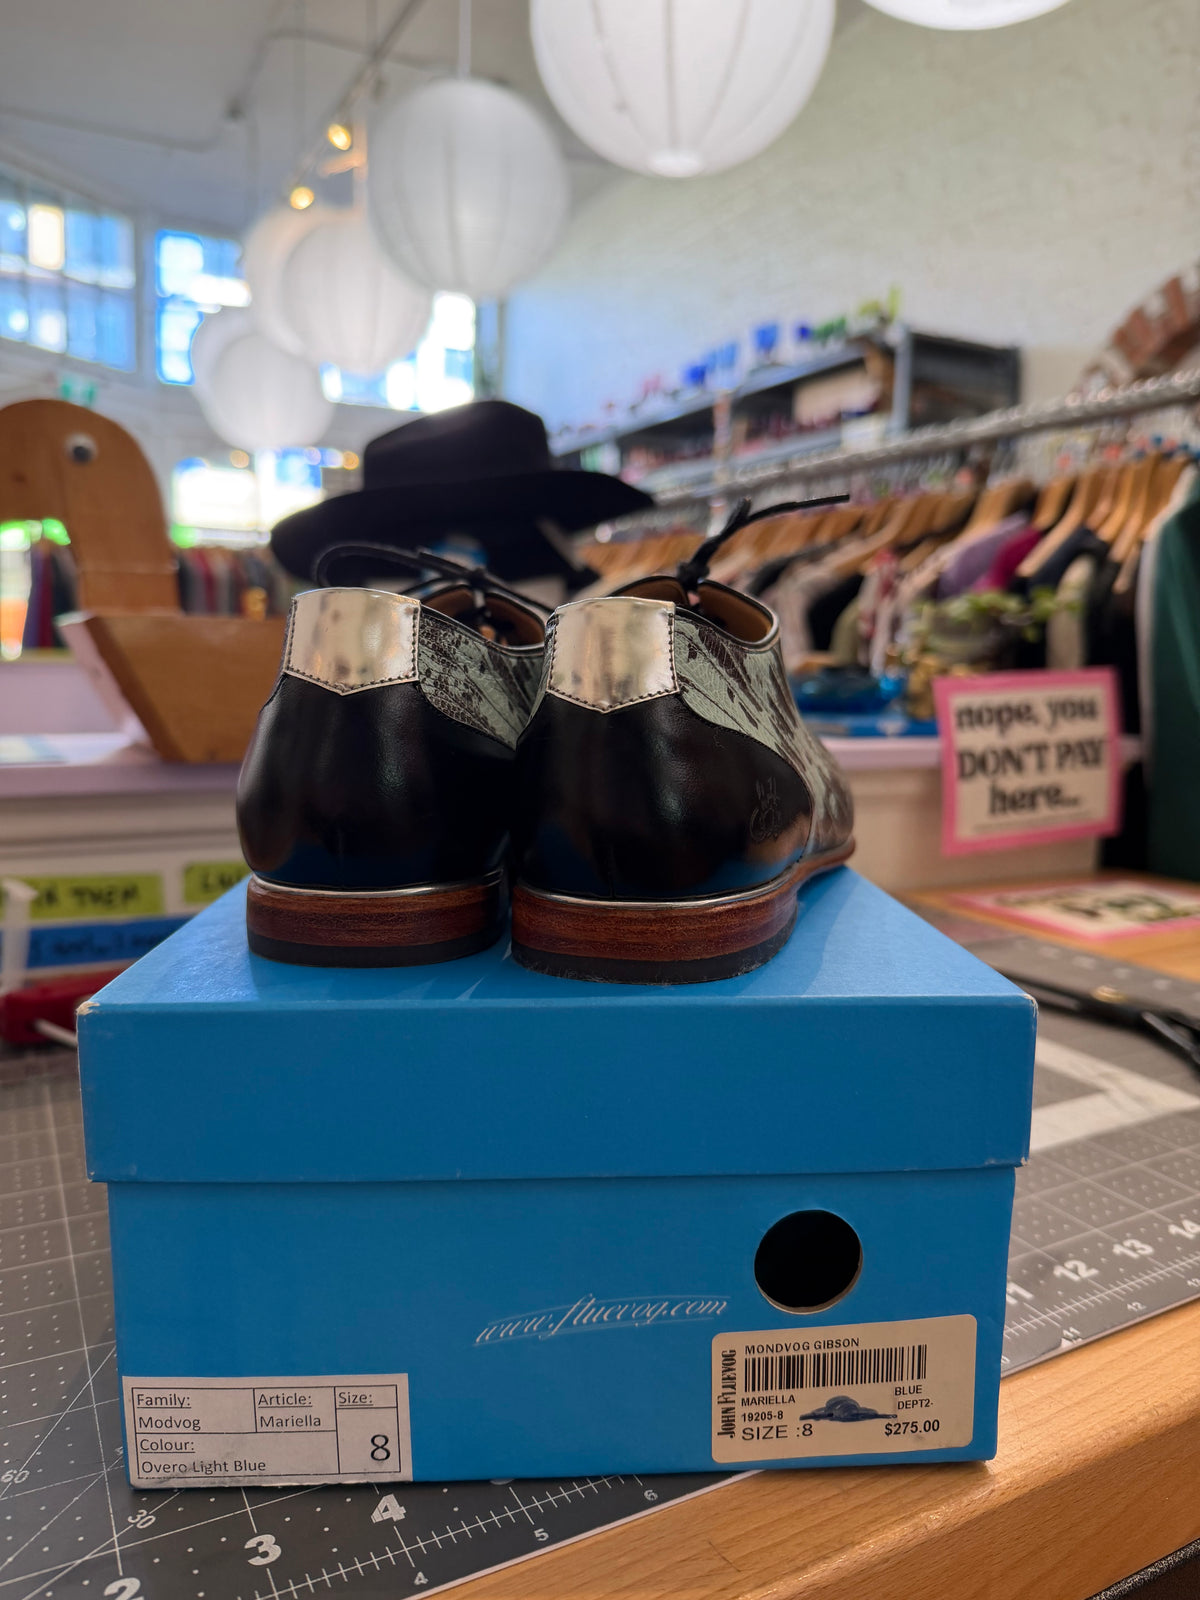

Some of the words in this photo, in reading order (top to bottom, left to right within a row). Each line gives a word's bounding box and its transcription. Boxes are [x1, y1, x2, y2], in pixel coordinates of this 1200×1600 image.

[955, 702, 1038, 736] nope,
[1045, 695, 1098, 731] you
[958, 742, 1049, 781] DON'T
[1056, 738, 1104, 772] PAY
[1168, 1218, 1200, 1240] 14
[1112, 1238, 1154, 1259] 13
[1053, 1259, 1099, 1282] 12
[475, 1293, 727, 1342] www.fluevog.com
[744, 1341, 810, 1355] MONDVOG
[813, 1337, 860, 1350] GIBSON
[338, 1391, 374, 1405] Size:
[894, 1384, 923, 1396] BLUE
[136, 1393, 191, 1408] Family:
[258, 1392, 313, 1406] Article:
[741, 1394, 796, 1407] MARIELLA
[897, 1398, 934, 1410] DEPT2-
[138, 1416, 201, 1431] Modvog
[259, 1415, 322, 1428] Mariella
[717, 1406, 736, 1439] JOHN
[741, 1410, 784, 1422] 19205-8
[741, 1424, 788, 1441] SIZE
[884, 1419, 940, 1437] $275.00
[139, 1438, 195, 1452] Colour:
[370, 1434, 391, 1462] 8
[141, 1461, 188, 1474] Overo
[192, 1460, 229, 1475] Light
[233, 1460, 266, 1472] Blue
[0, 1469, 30, 1484] 60
[643, 1489, 658, 1501] 6
[370, 1493, 407, 1524] 4
[127, 1508, 156, 1530] 30
[533, 1528, 549, 1542] 5
[244, 1534, 282, 1566] 3
[413, 1571, 429, 1586] 4
[103, 1577, 145, 1600] 2
